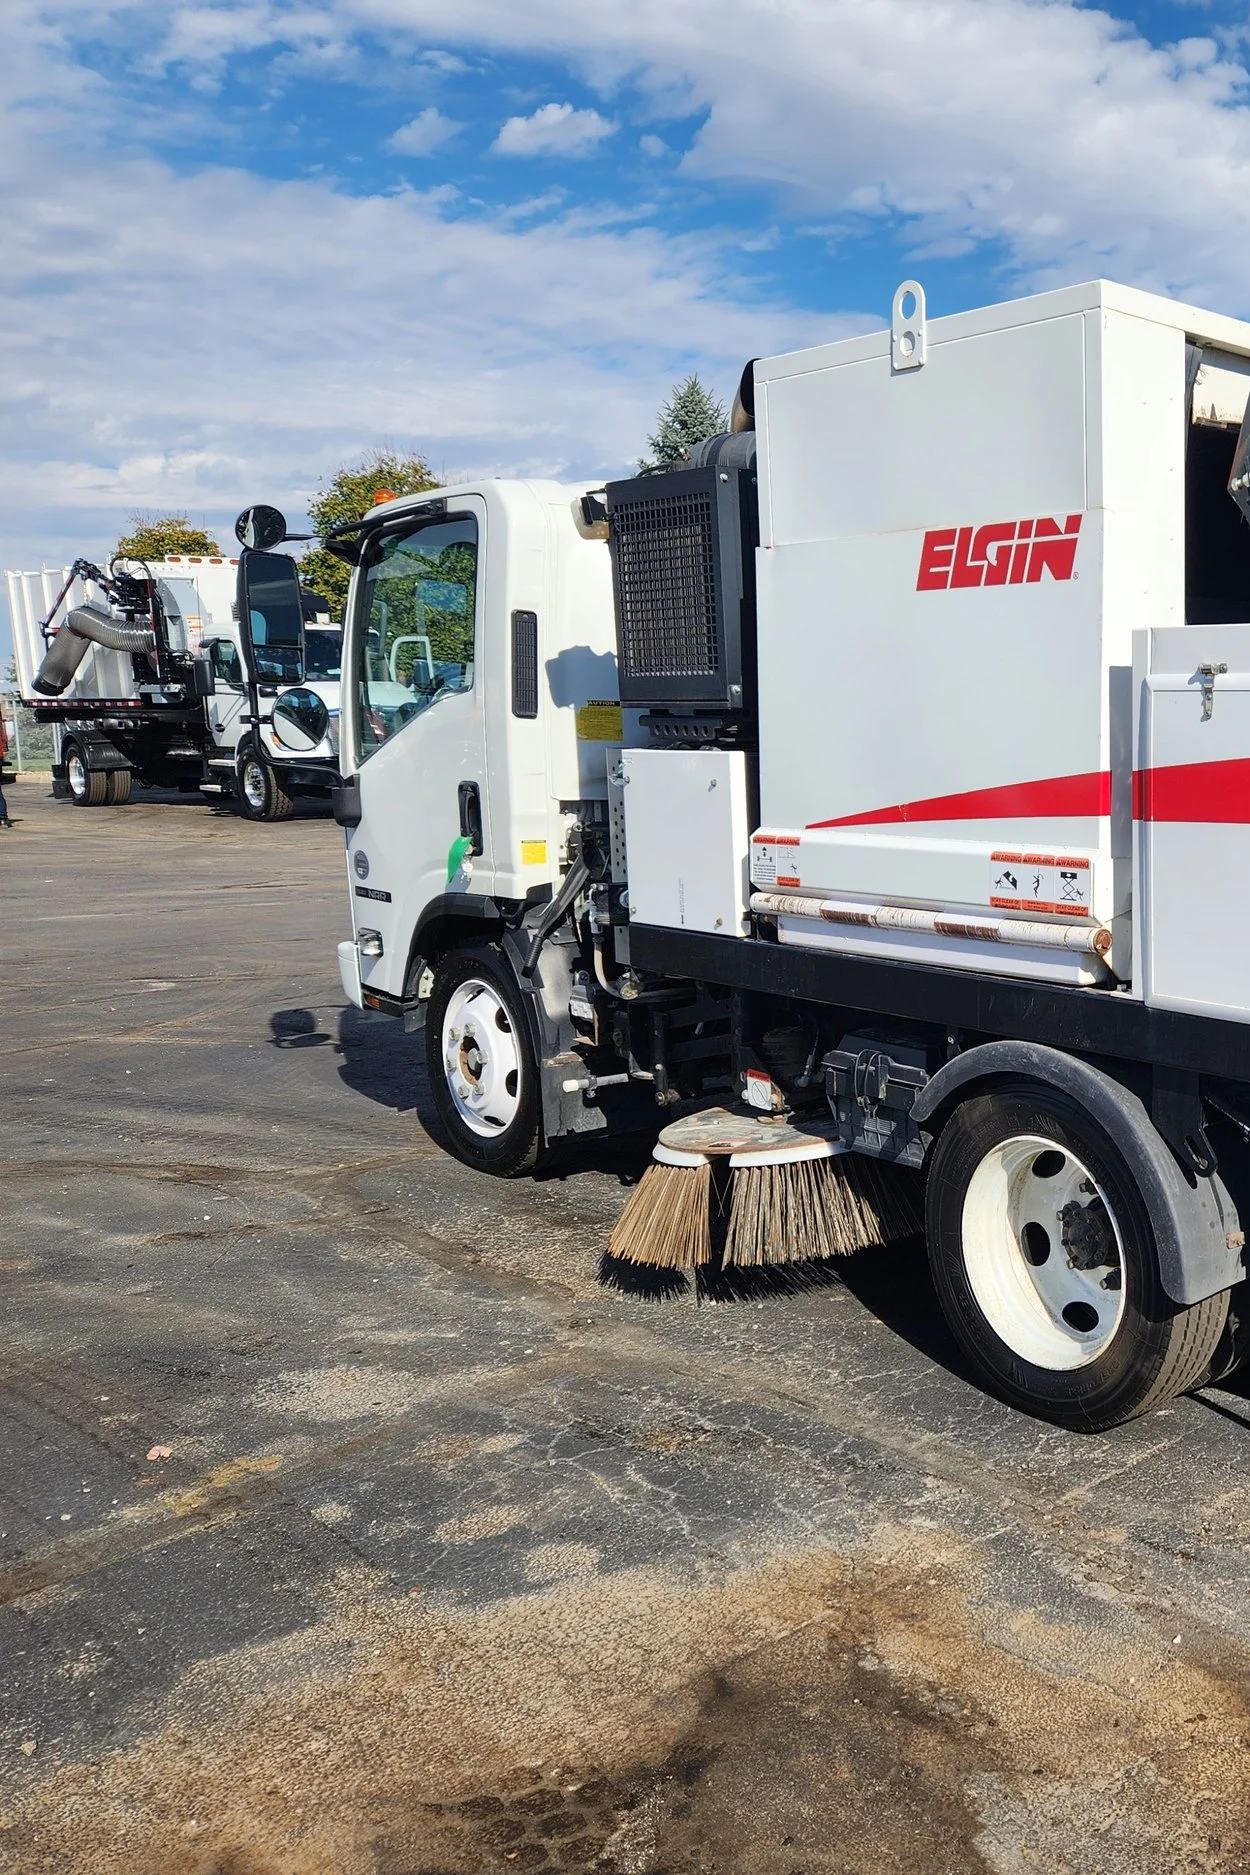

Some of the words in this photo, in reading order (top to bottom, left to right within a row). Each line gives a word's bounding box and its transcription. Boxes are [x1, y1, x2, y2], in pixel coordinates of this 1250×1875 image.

[916, 514, 1083, 592] ELGIN
[994, 854, 1021, 863] WARNING
[1026, 857, 1054, 865] WARNING
[1060, 860, 1089, 869] WARNING
